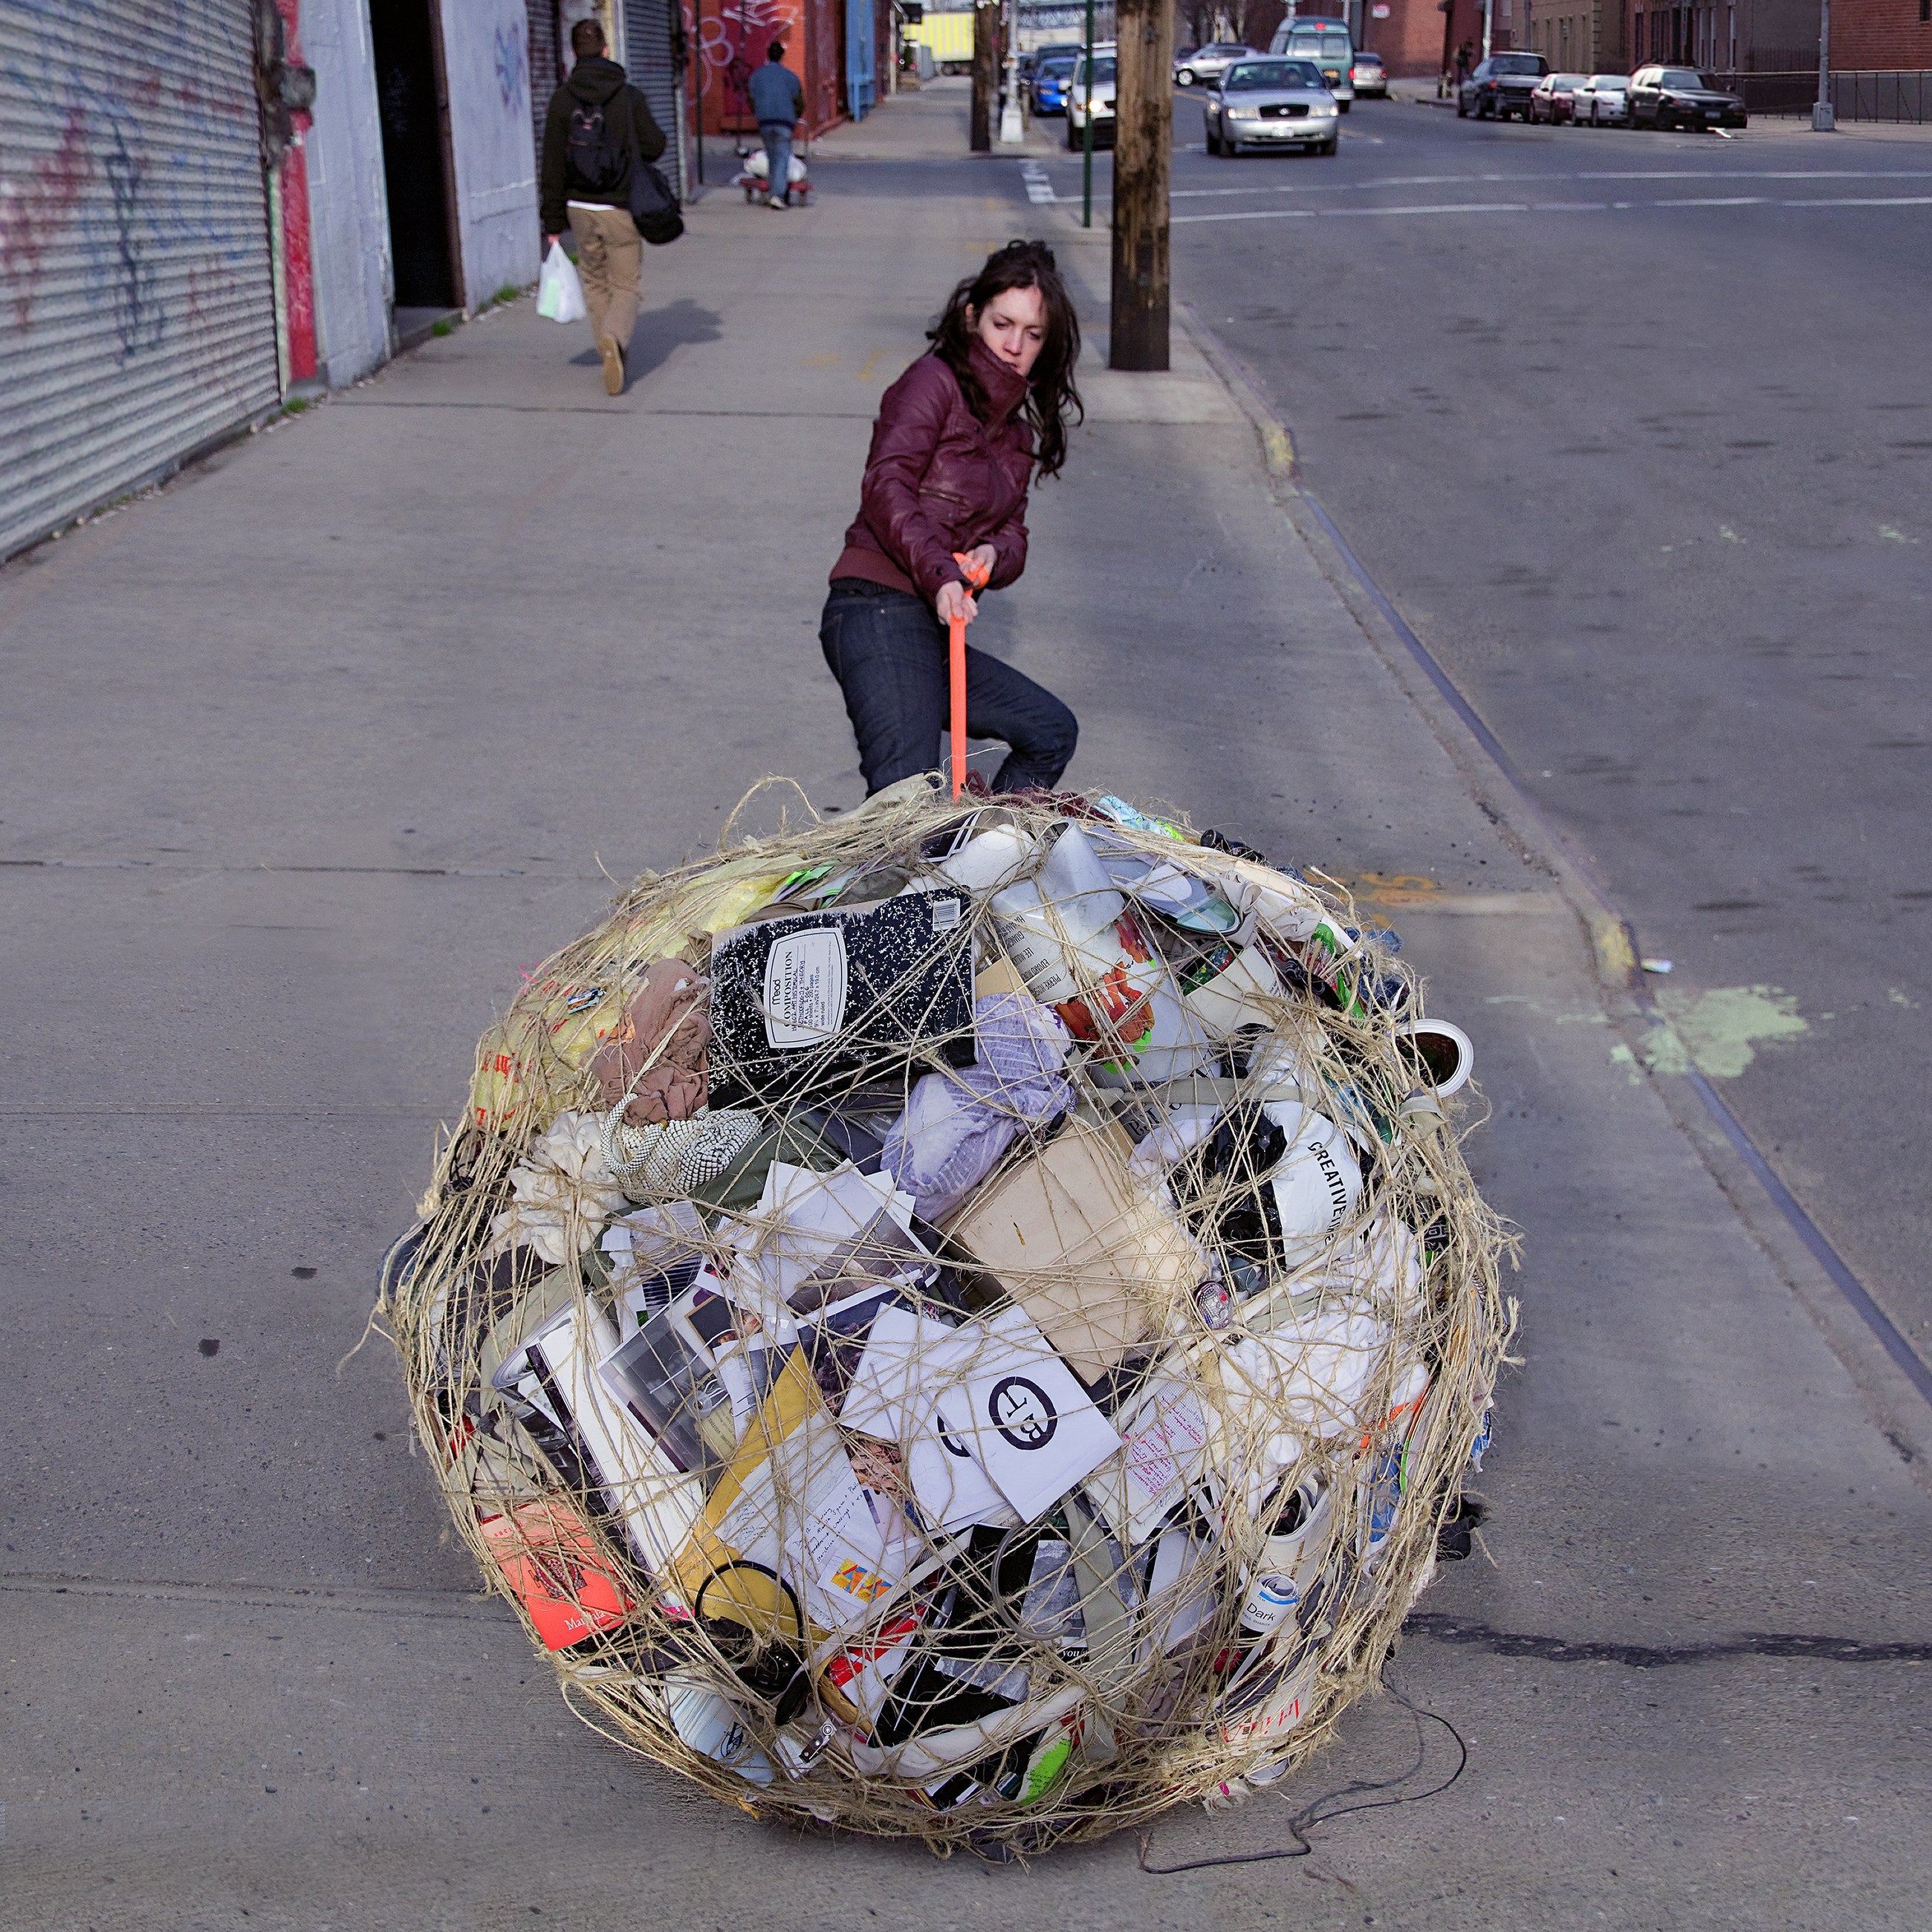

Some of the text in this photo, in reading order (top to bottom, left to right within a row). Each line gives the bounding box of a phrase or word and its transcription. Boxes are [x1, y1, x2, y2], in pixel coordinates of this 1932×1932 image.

[1023, 947, 1034, 958] LEE
[1044, 973, 1061, 990] PIERRE
[772, 979, 781, 1005] Mead
[563, 1610, 606, 1631] Maala
[1247, 1602, 1276, 1621] Dark
